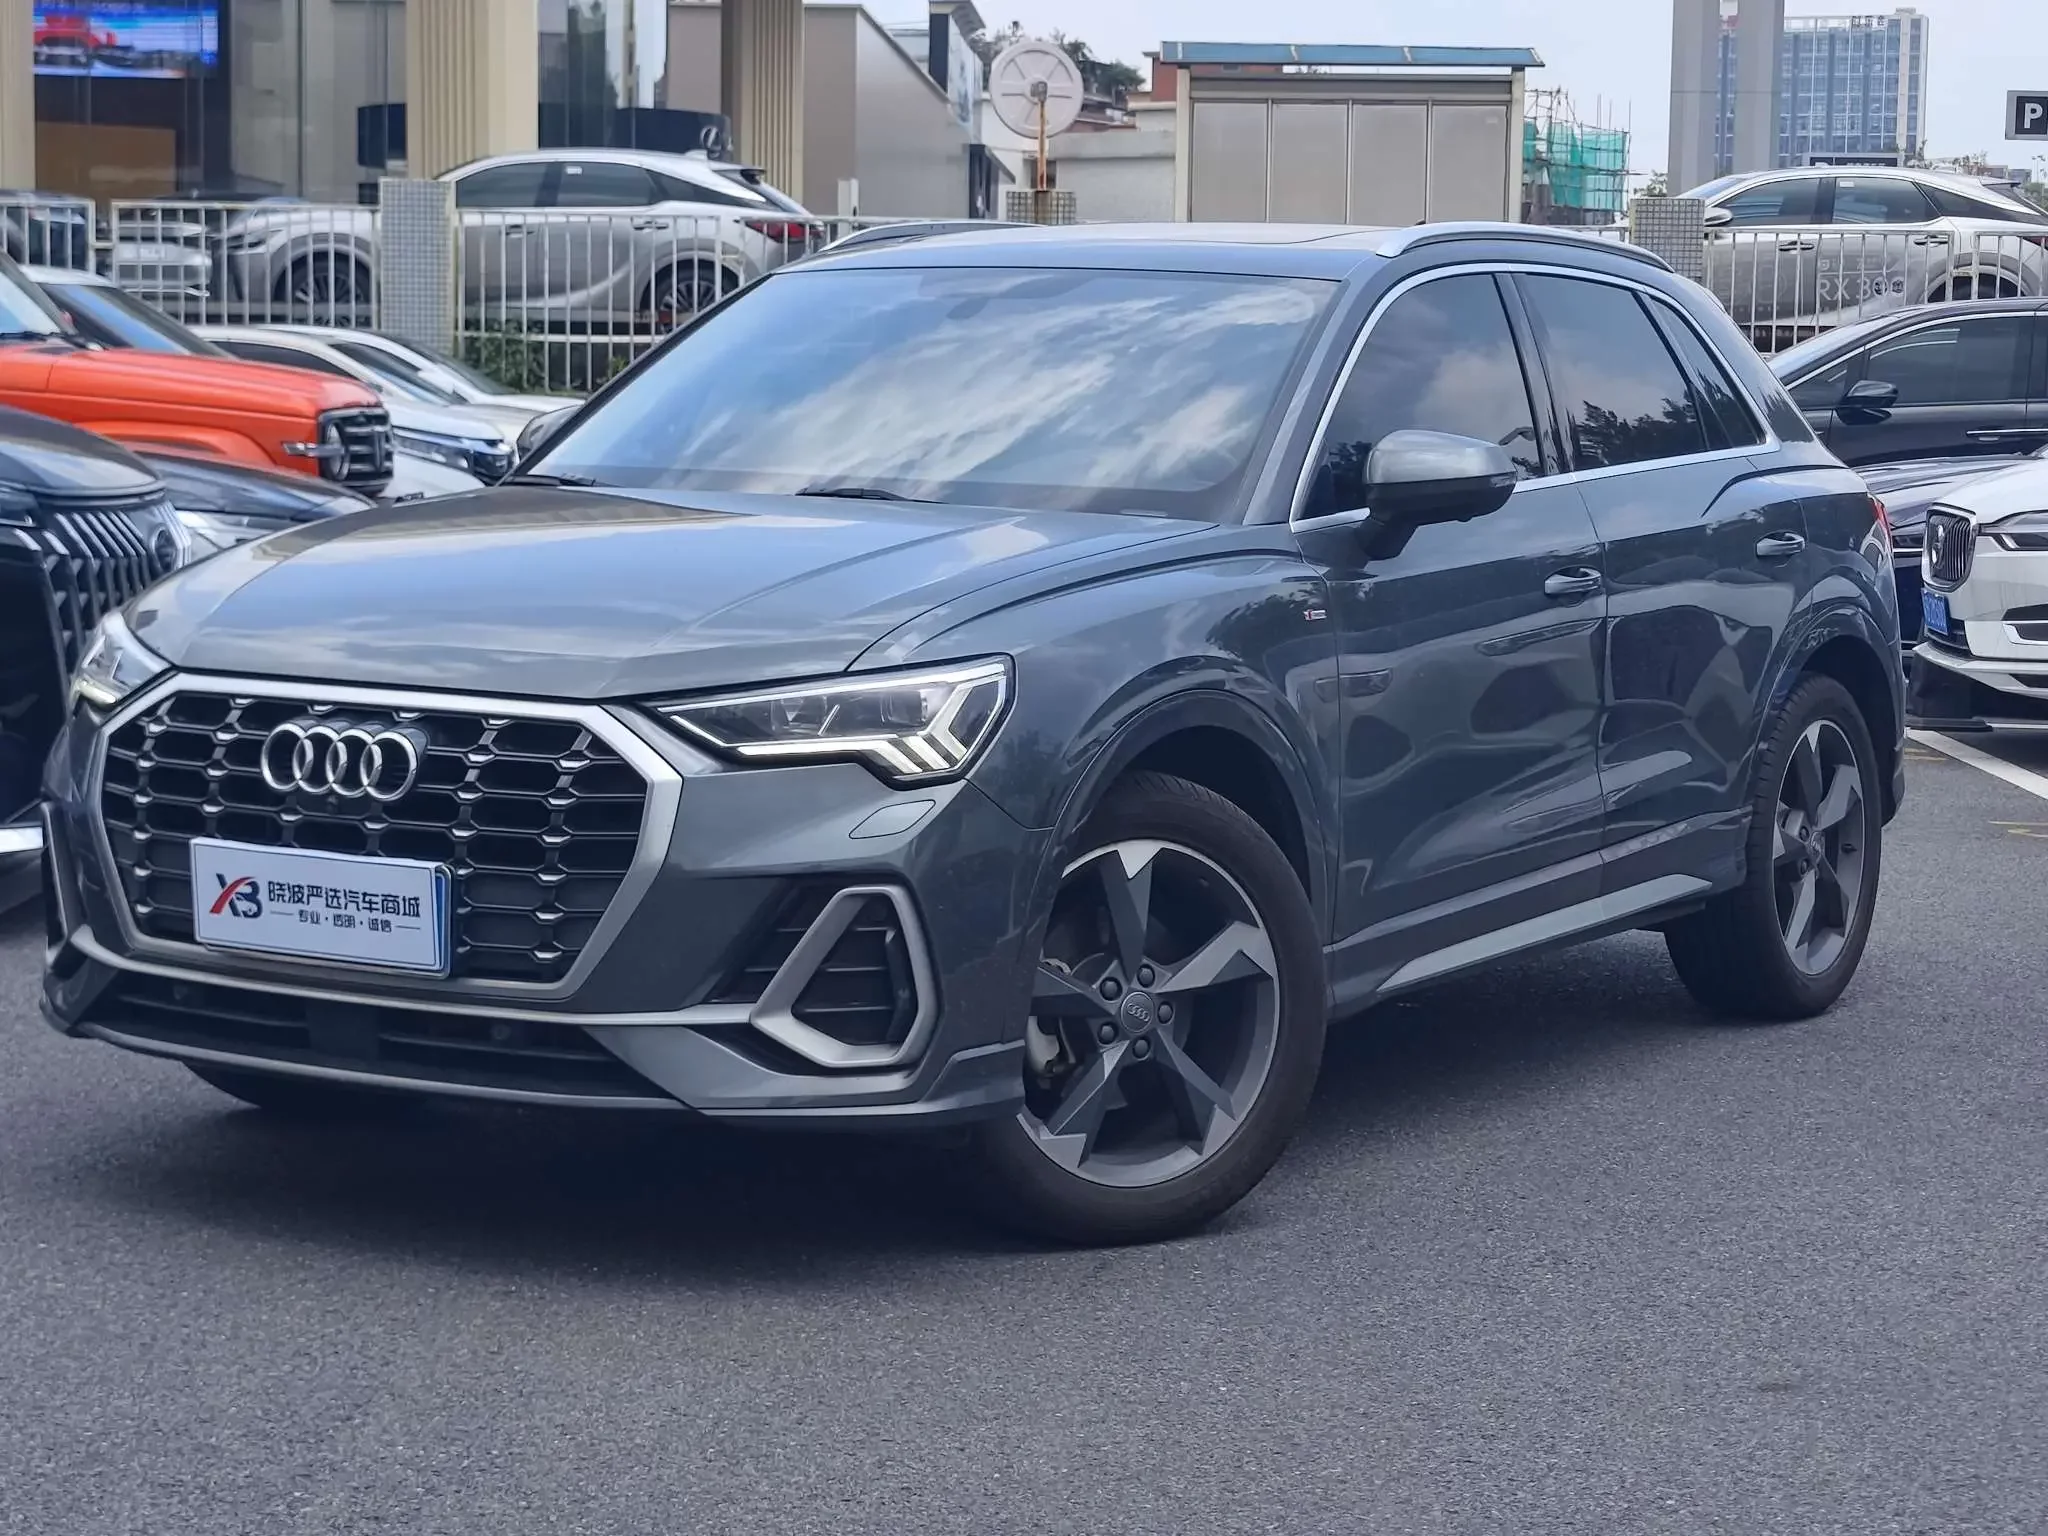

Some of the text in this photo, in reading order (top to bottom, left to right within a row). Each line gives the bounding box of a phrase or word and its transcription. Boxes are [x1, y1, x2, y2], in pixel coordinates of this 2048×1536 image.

[2024, 102, 2043, 129] P
[1817, 278, 1850, 300] RX
[267, 880, 421, 918] 晓波严选汽车商城
